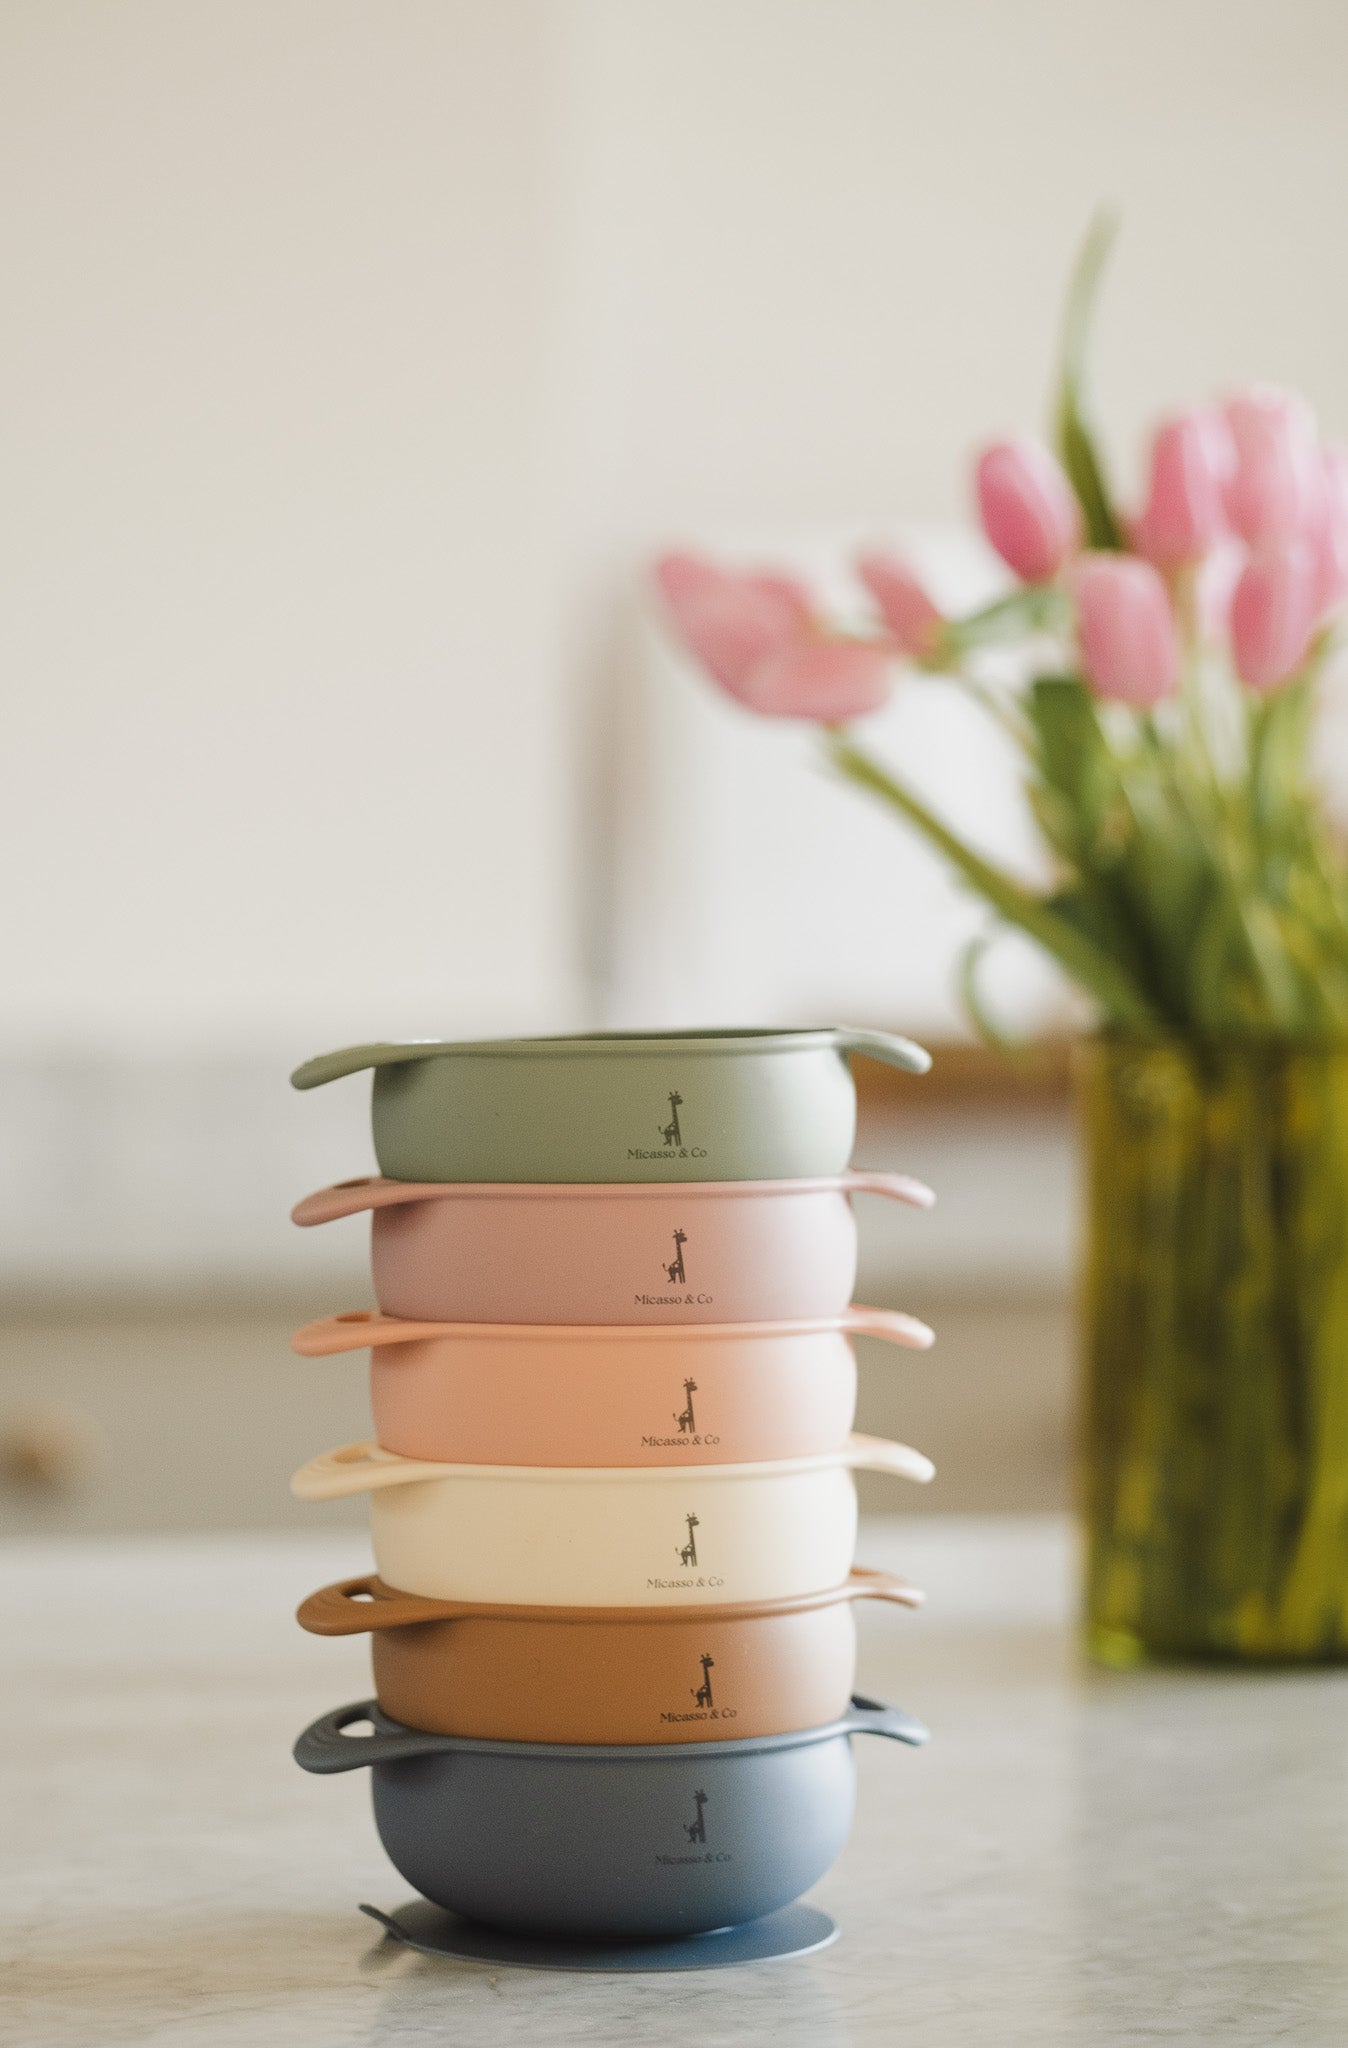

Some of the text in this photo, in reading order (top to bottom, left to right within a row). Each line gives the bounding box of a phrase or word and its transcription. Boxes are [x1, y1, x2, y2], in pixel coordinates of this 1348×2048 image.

[627, 1147, 707, 1159] Micasso & Co
[634, 1293, 713, 1305] Micasso & Co
[641, 1434, 720, 1447] Micasso & Co
[646, 1576, 724, 1589] Micasso & Co
[660, 1708, 737, 1723] Micasso & Co
